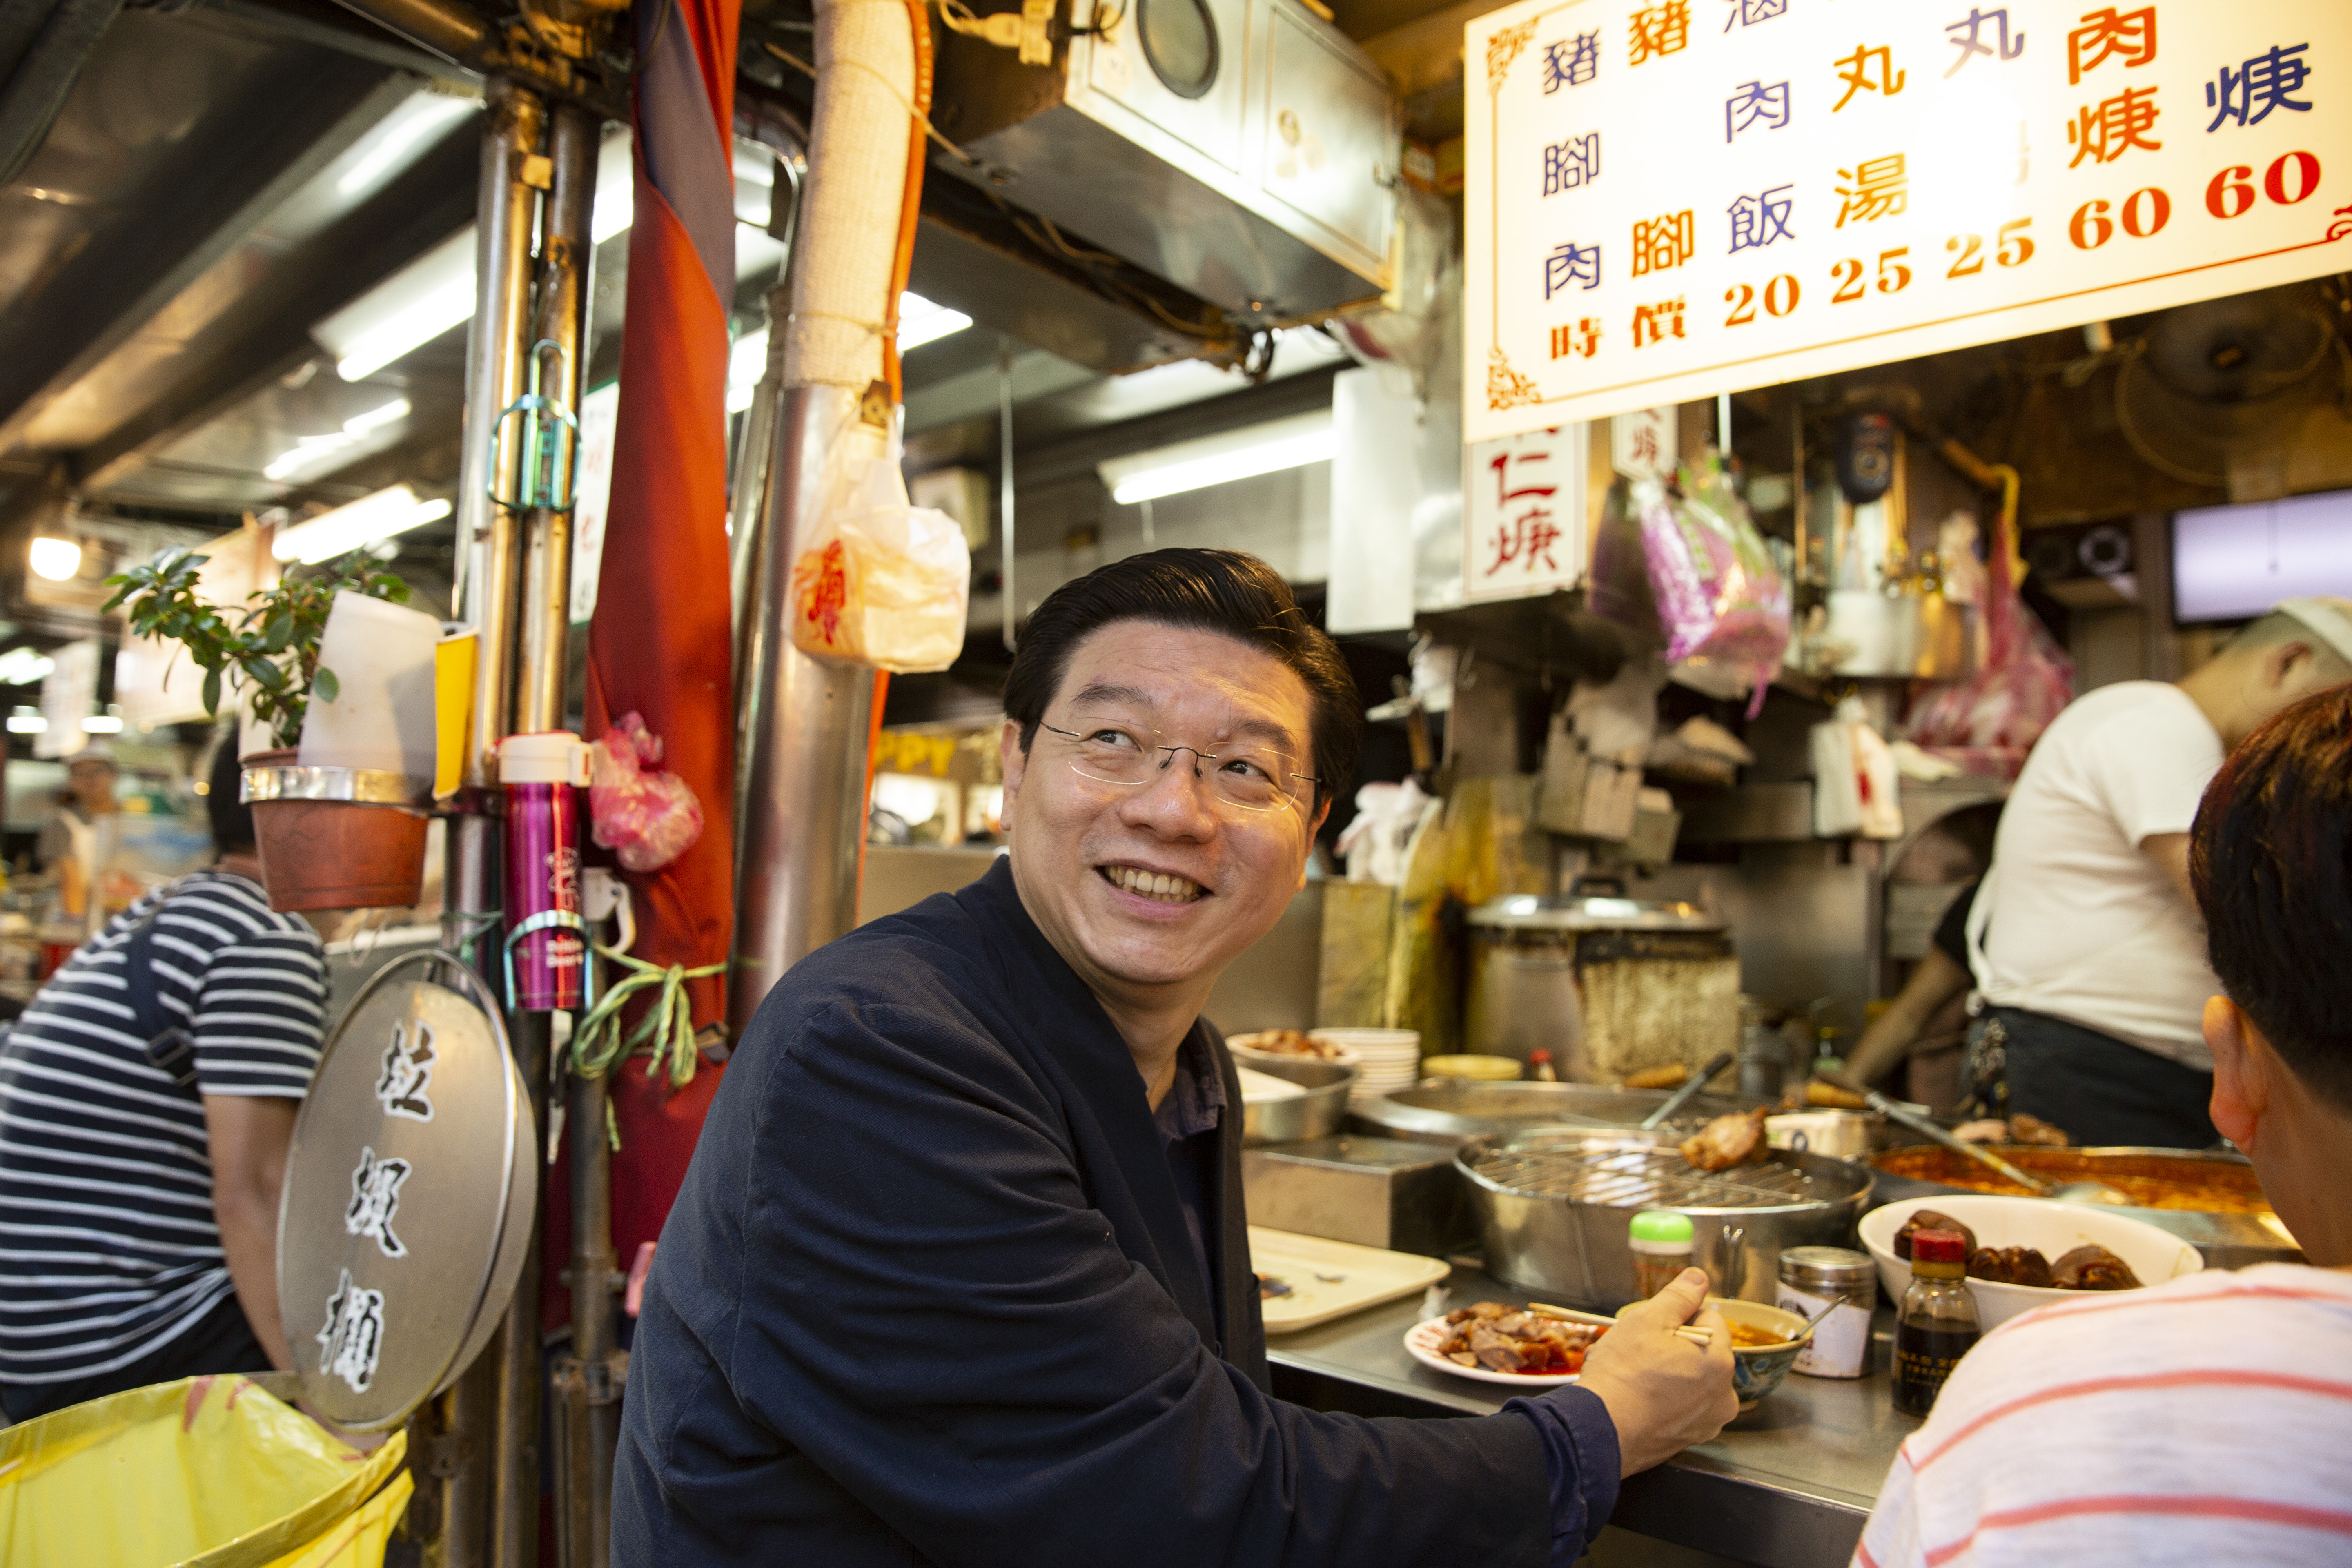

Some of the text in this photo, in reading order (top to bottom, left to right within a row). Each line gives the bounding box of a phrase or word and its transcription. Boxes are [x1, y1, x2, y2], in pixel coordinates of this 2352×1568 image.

[1543, 28, 1601, 301] 豬腳肉
[1832, 45, 1909, 229] 丸湯
[2205, 151, 2321, 219] 60
[1945, 216, 2035, 280] 25
[2068, 187, 2171, 250] 60
[1724, 274, 1800, 327] 20
[1831, 246, 1911, 304] 25
[1484, 427, 1562, 577] 仁焿
